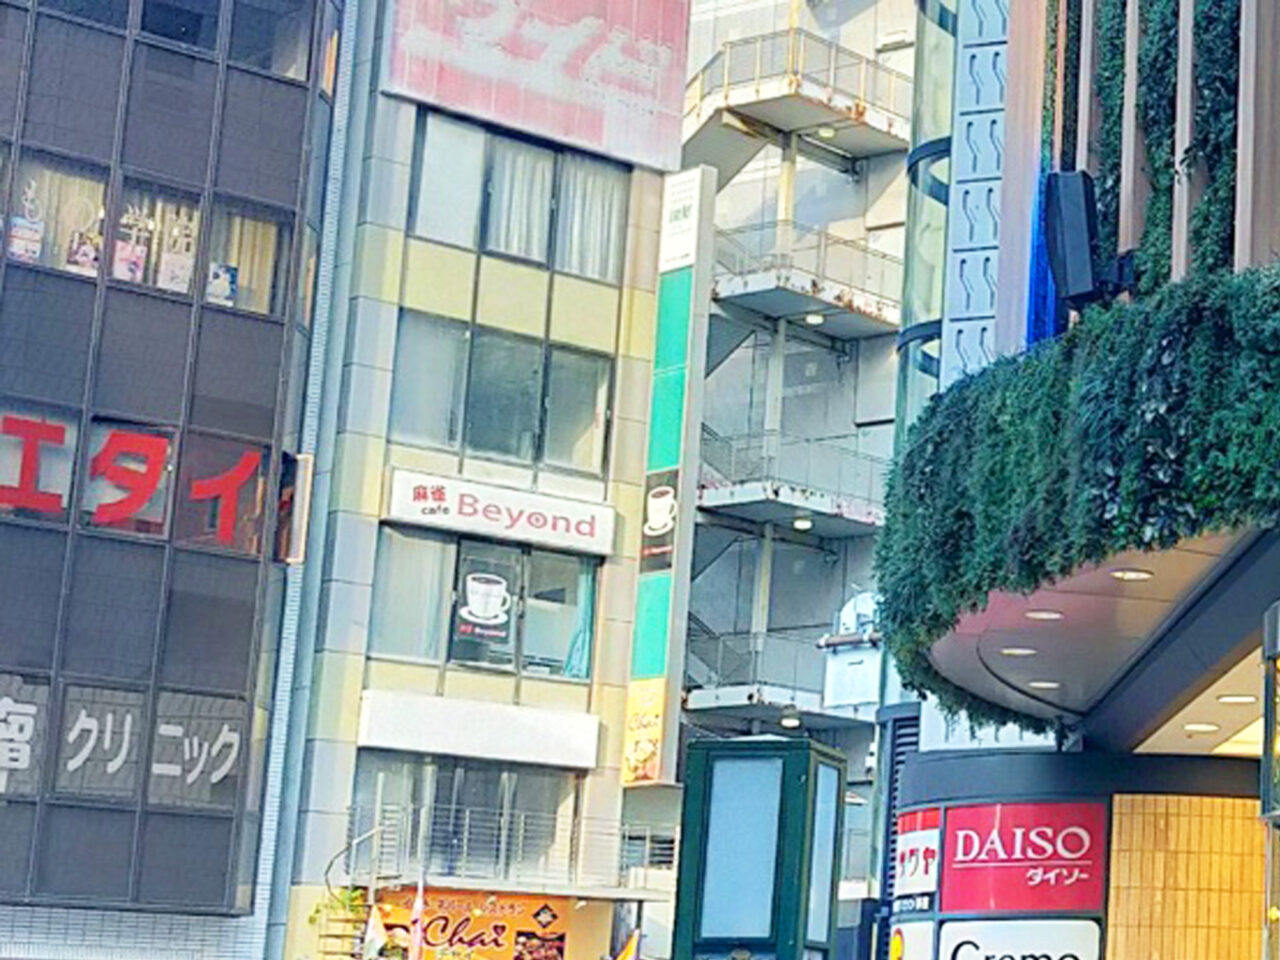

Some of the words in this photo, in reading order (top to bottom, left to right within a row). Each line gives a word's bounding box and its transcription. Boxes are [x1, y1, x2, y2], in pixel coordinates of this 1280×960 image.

[412, 484, 447, 502] 麻雀
[421, 504, 450, 516] cafe
[457, 493, 597, 538] Beyond
[954, 826, 1091, 861] DAISO
[1026, 867, 1090, 886] ダイソー
[423, 915, 505, 948] Chai
